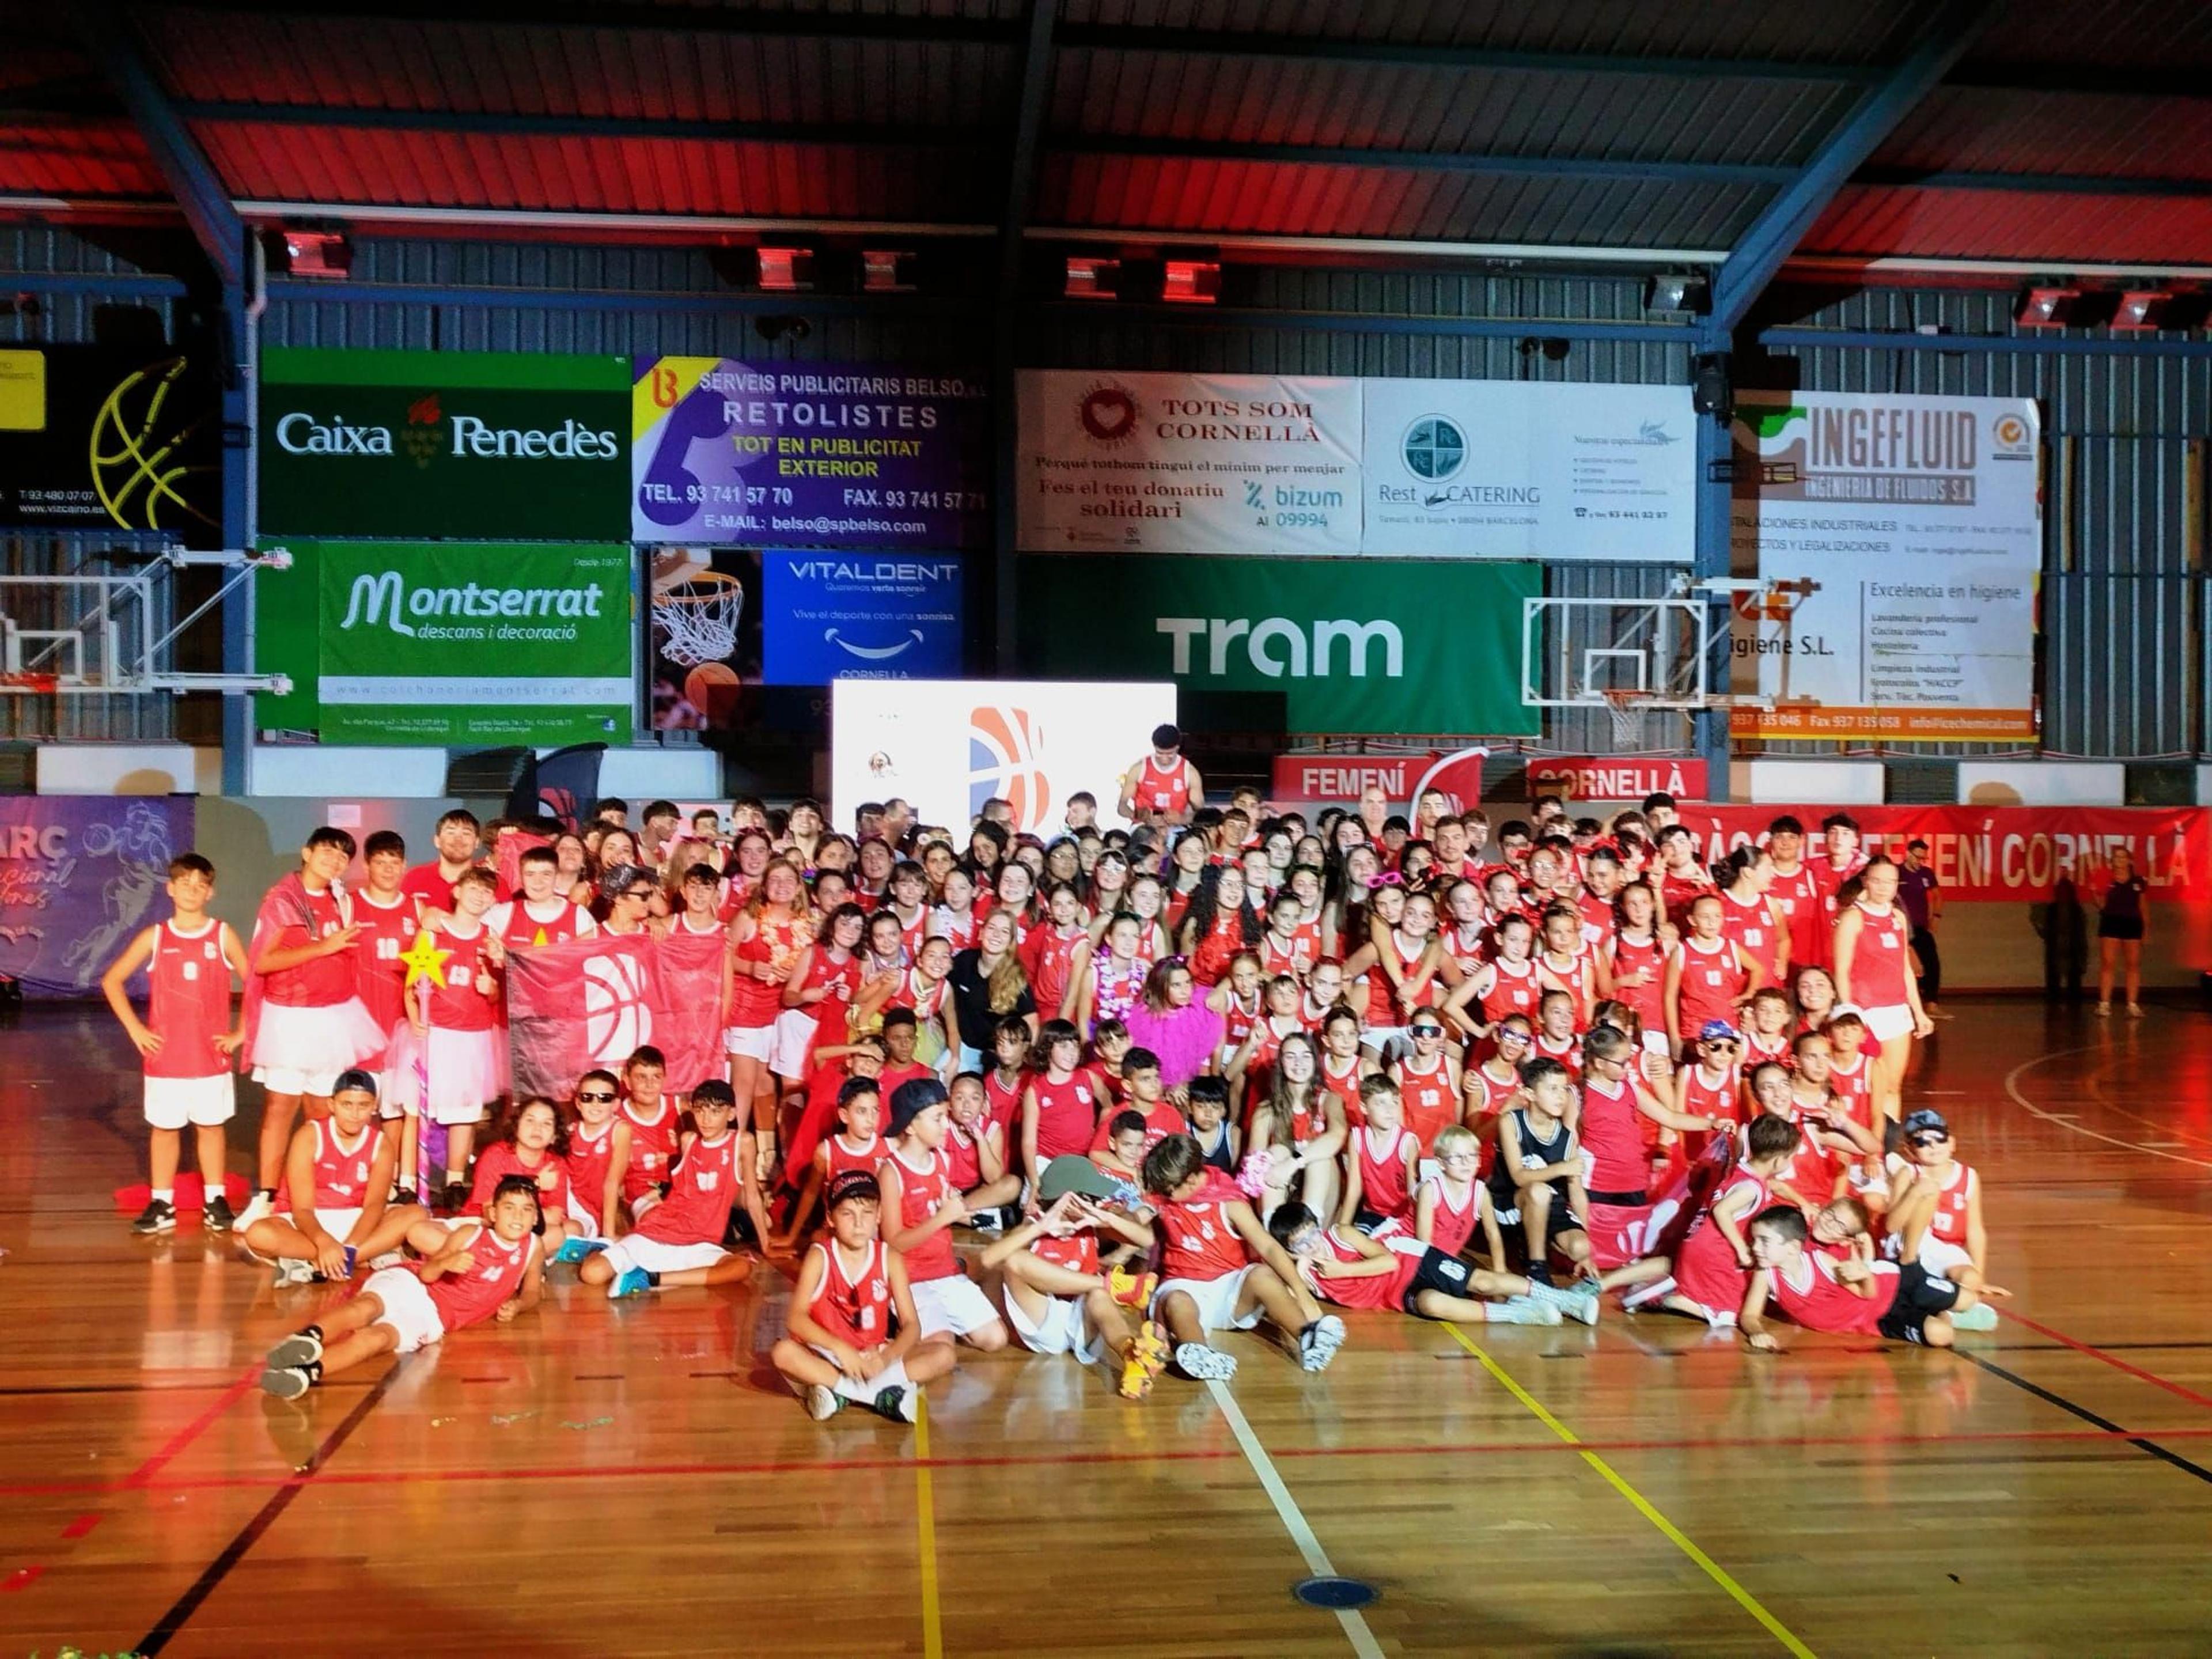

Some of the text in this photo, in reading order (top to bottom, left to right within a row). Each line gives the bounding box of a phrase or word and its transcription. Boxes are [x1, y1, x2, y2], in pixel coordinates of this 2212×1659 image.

[700, 373, 775, 393] SERVEIS
[781, 375, 900, 395] PUBLICITARIS
[723, 401, 938, 428] RETOLISTES
[1162, 399, 1313, 418] TOTS SOM
[276, 412, 619, 460] Caixa Penedès
[1157, 422, 1320, 443] CORNELLÀ
[1812, 407, 1976, 470] INGEFLUID
[733, 437, 922, 457] TOT EN PUBLICITAT
[779, 460, 879, 477] EXTERIOR
[1093, 459, 1145, 470] tothom
[1149, 460, 1194, 472] tingui
[1197, 461, 1210, 472] el
[1266, 464, 1288, 475] per
[1293, 464, 1345, 475] menjar
[28, 490, 42, 500] 93
[44, 491, 64, 501] 480
[643, 484, 793, 505] TEL. 93 741 57 70
[1039, 479, 1225, 497] Fes el teu donatiu
[1275, 485, 1343, 507] bizum
[1380, 484, 1540, 503] Rest CATERING
[844, 489, 882, 507] FAX.
[886, 491, 905, 507] 93
[911, 491, 938, 509] 741
[944, 492, 963, 509] 57
[1080, 499, 1181, 518] solidari
[704, 514, 926, 533] E-MAIL: belso@spbelso.com
[1275, 513, 1328, 527] 09994
[789, 562, 959, 581] VITALDENT
[825, 582, 870, 592] Queremos
[1870, 582, 2021, 602] Excelencia en higiene
[340, 571, 603, 637] Montserrat
[793, 609, 816, 619] Vive
[818, 609, 828, 619] el
[830, 609, 871, 622] deporte
[873, 612, 893, 620] con
[895, 612, 914, 621] una
[418, 623, 577, 640] descans i decoració
[1729, 633, 1835, 658] igiene S.L.
[1809, 715, 1831, 726] Fax
[1302, 761, 1407, 796] FEMENÍ
